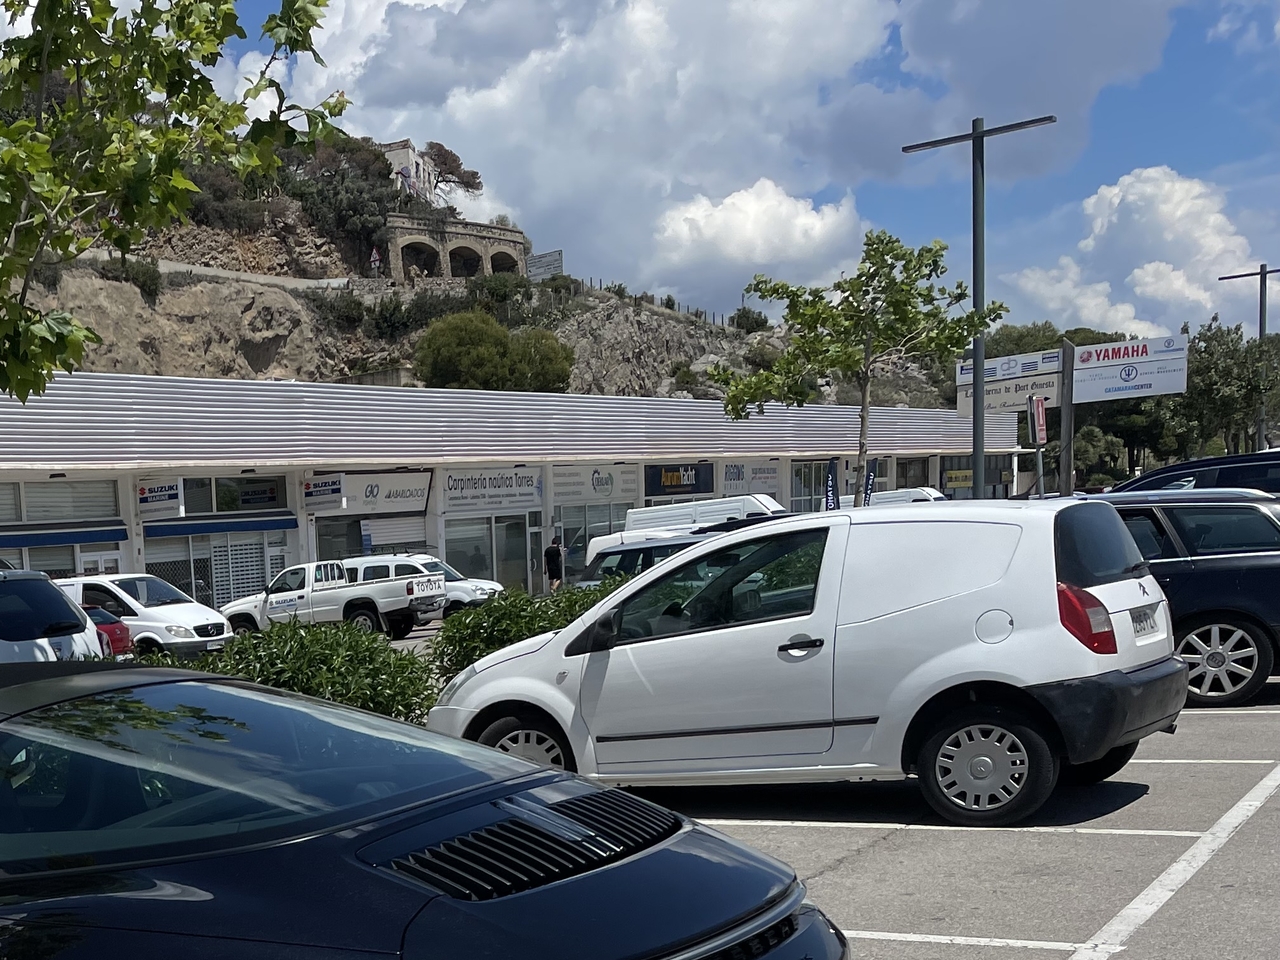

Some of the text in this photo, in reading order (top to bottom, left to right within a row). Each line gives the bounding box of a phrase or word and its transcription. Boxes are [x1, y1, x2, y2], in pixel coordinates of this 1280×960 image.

[1095, 344, 1149, 362] YAMAHA
[312, 480, 340, 489] SUZUKI
[514, 473, 534, 487] Torres
[148, 484, 178, 494] SUZUKI
[865, 472, 875, 507] OHATSU
[147, 494, 169, 502] MARINE
[416, 582, 442, 593] TOYOTA
